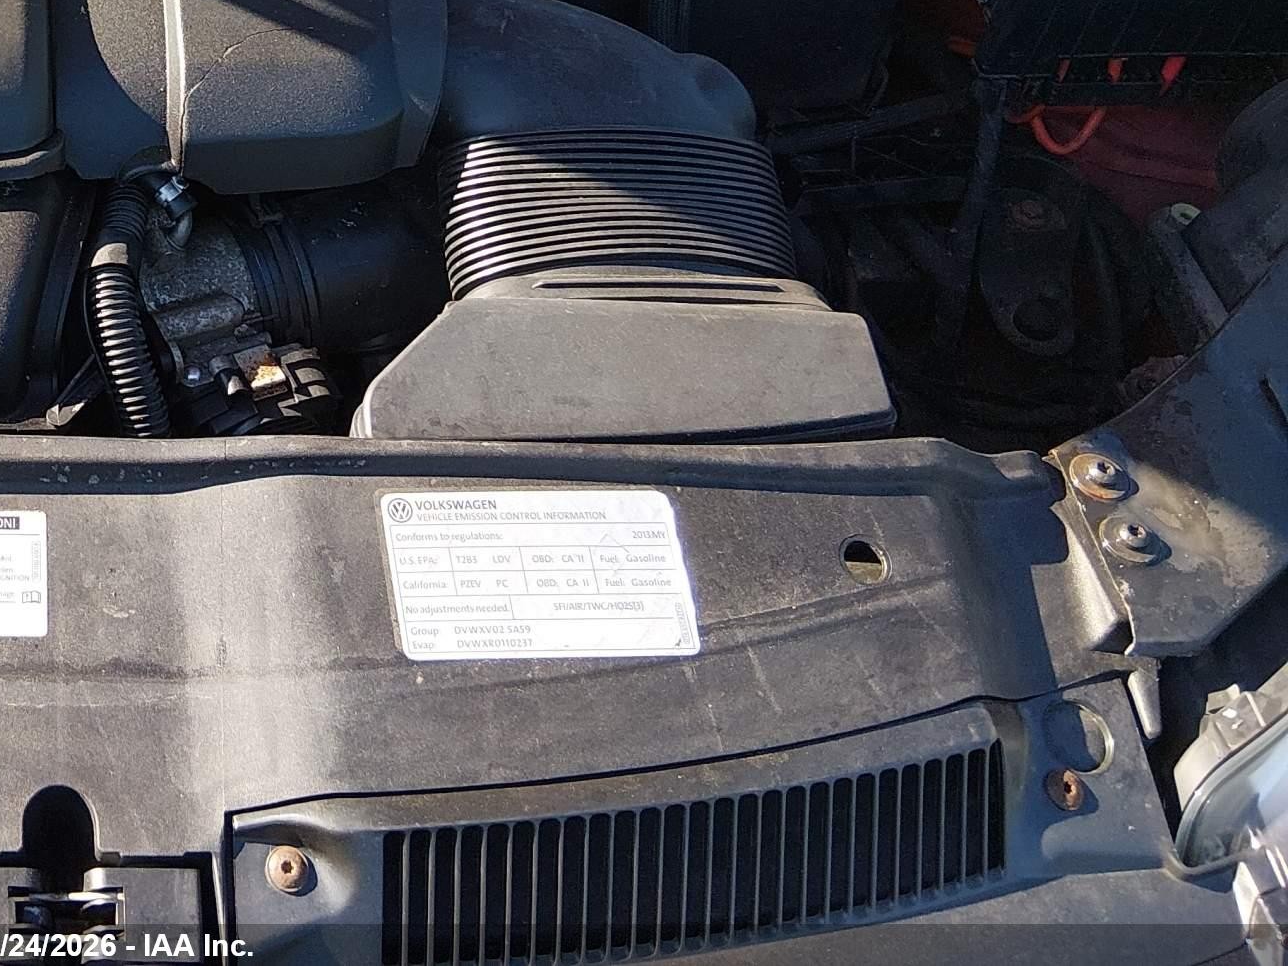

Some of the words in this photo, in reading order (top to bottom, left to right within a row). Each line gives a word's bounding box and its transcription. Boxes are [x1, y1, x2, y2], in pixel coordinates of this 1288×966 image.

[414, 499, 497, 511] VOLKSWAGEN
[416, 512, 453, 521] VEHICLE
[455, 512, 498, 521] EMISSION
[500, 512, 542, 521] CONTROL
[543, 511, 607, 520] INFORMATION
[395, 532, 438, 542] Conforms
[440, 532, 450, 541] to
[626, 554, 666, 563] Gasoline
[496, 579, 509, 588] PC
[566, 578, 579, 587] CA
[631, 578, 672, 587] Gasoline
[405, 605, 418, 614] No
[420, 604, 474, 616] adjustments
